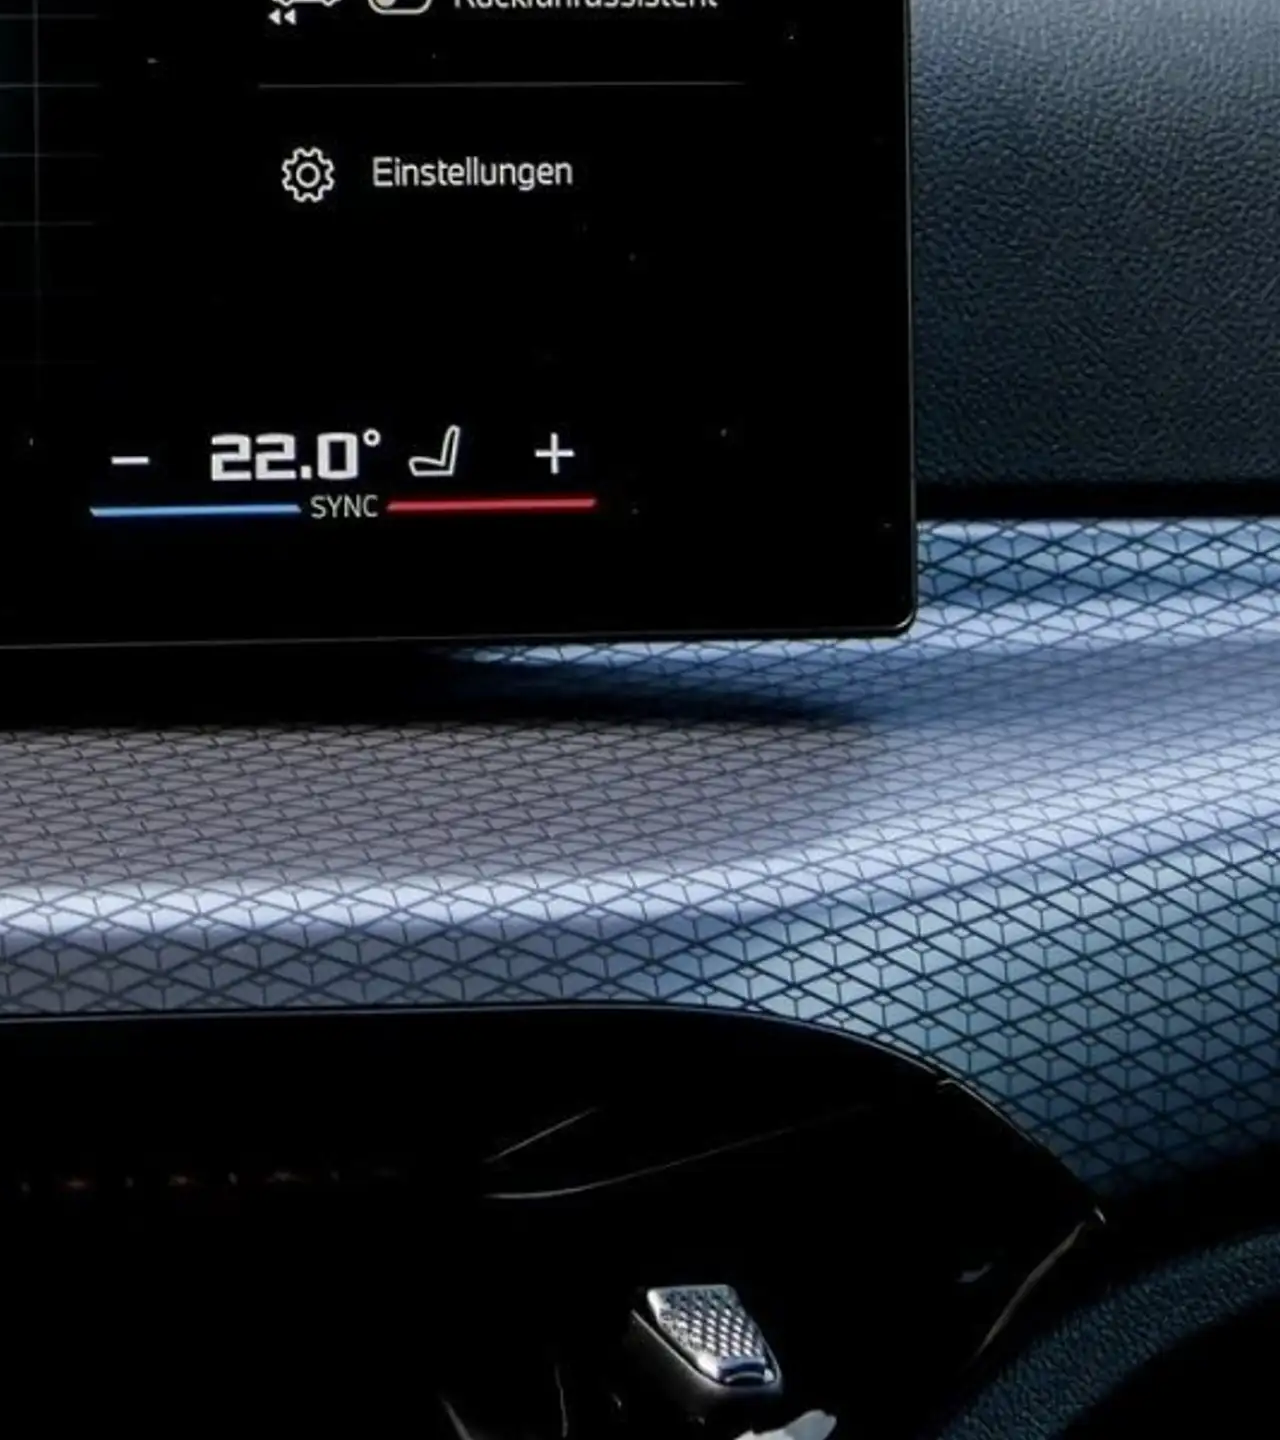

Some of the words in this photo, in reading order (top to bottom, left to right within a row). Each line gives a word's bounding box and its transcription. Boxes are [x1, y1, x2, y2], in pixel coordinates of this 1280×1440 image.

[373, 156, 573, 191] Einstellungen
[211, 428, 382, 481] 22.0°
[310, 494, 378, 519] SYNC
